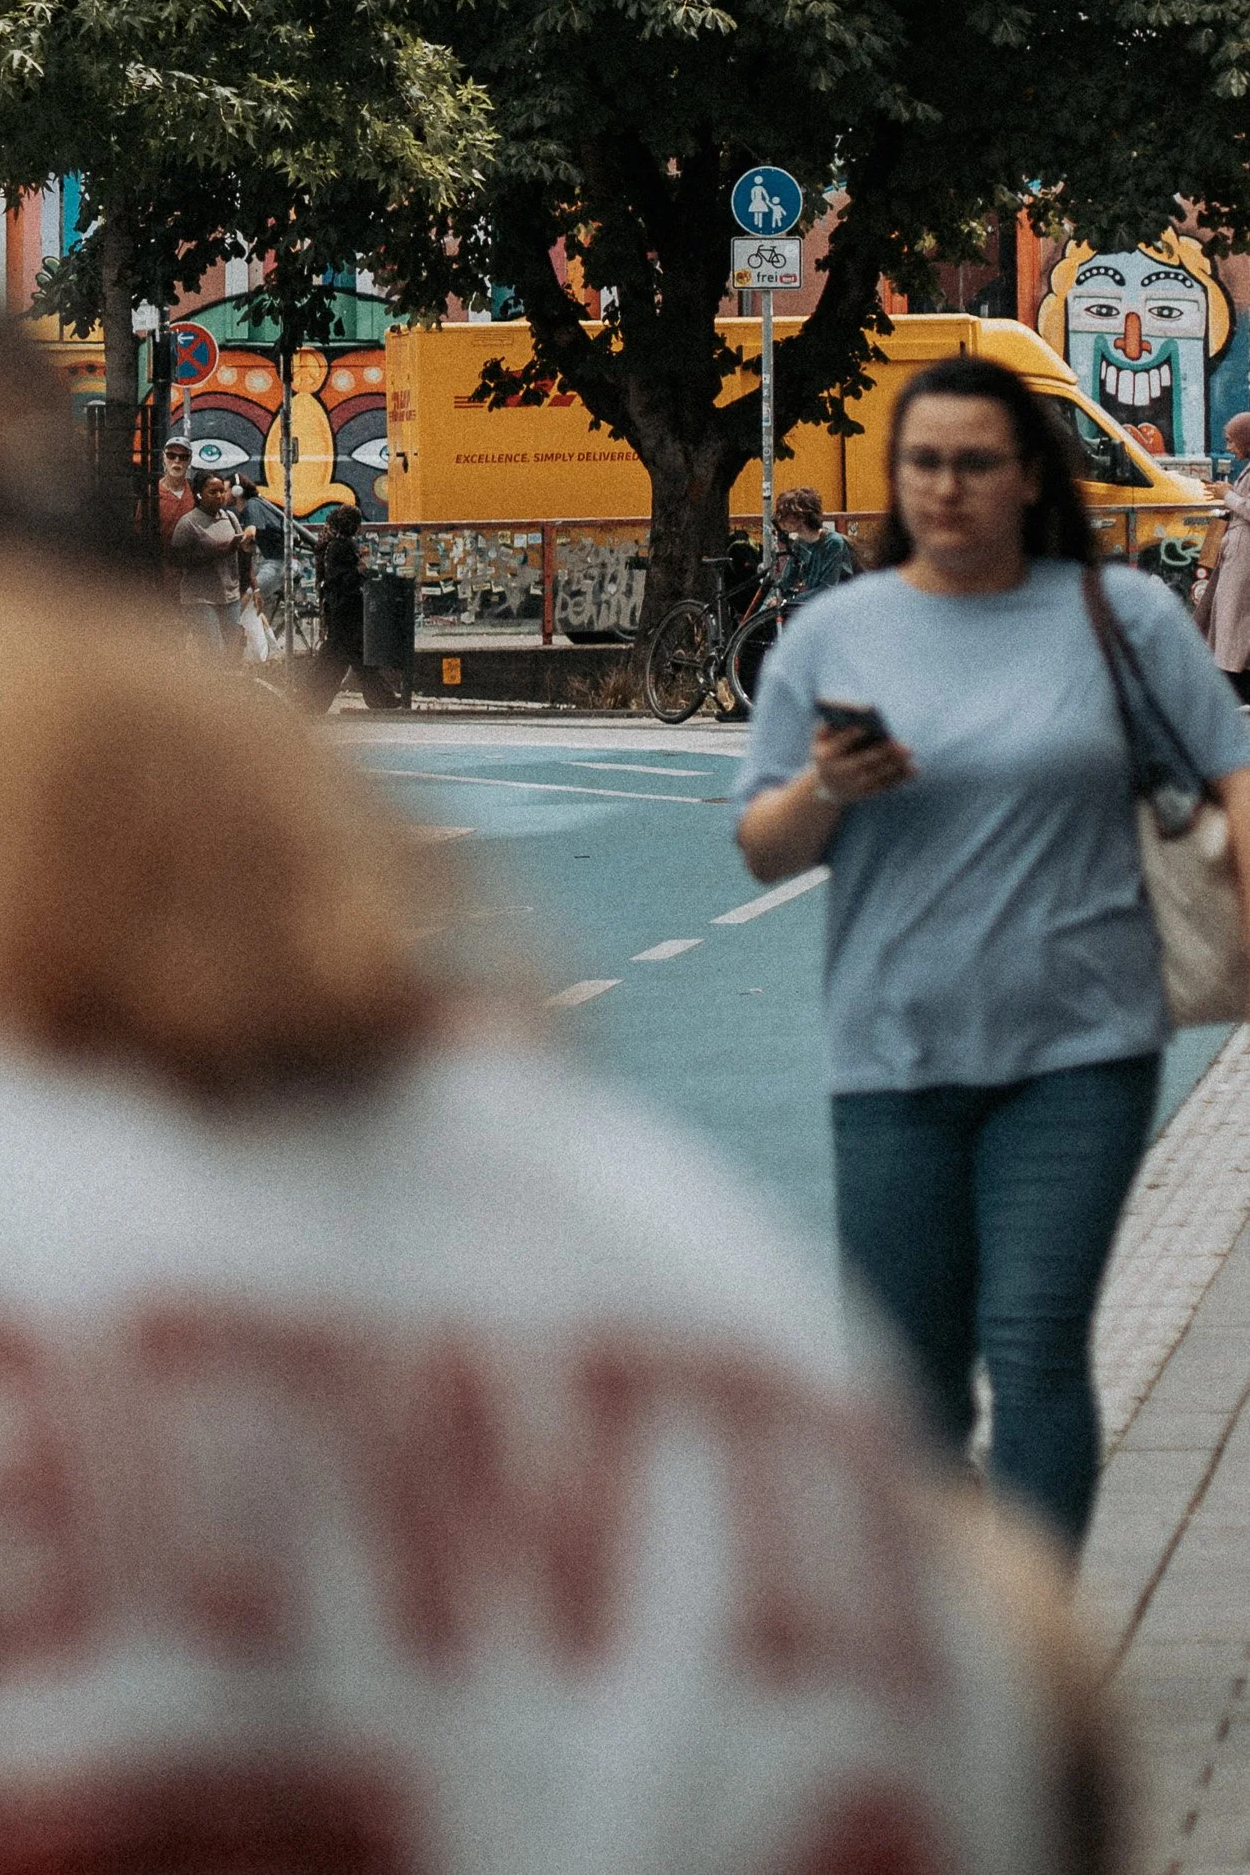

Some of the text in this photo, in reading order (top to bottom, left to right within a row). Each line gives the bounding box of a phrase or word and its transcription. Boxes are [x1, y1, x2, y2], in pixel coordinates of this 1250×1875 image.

[756, 271, 778, 283] frei
[455, 451, 639, 464] EXCELLENCE. SIMPLY DELIVERED
